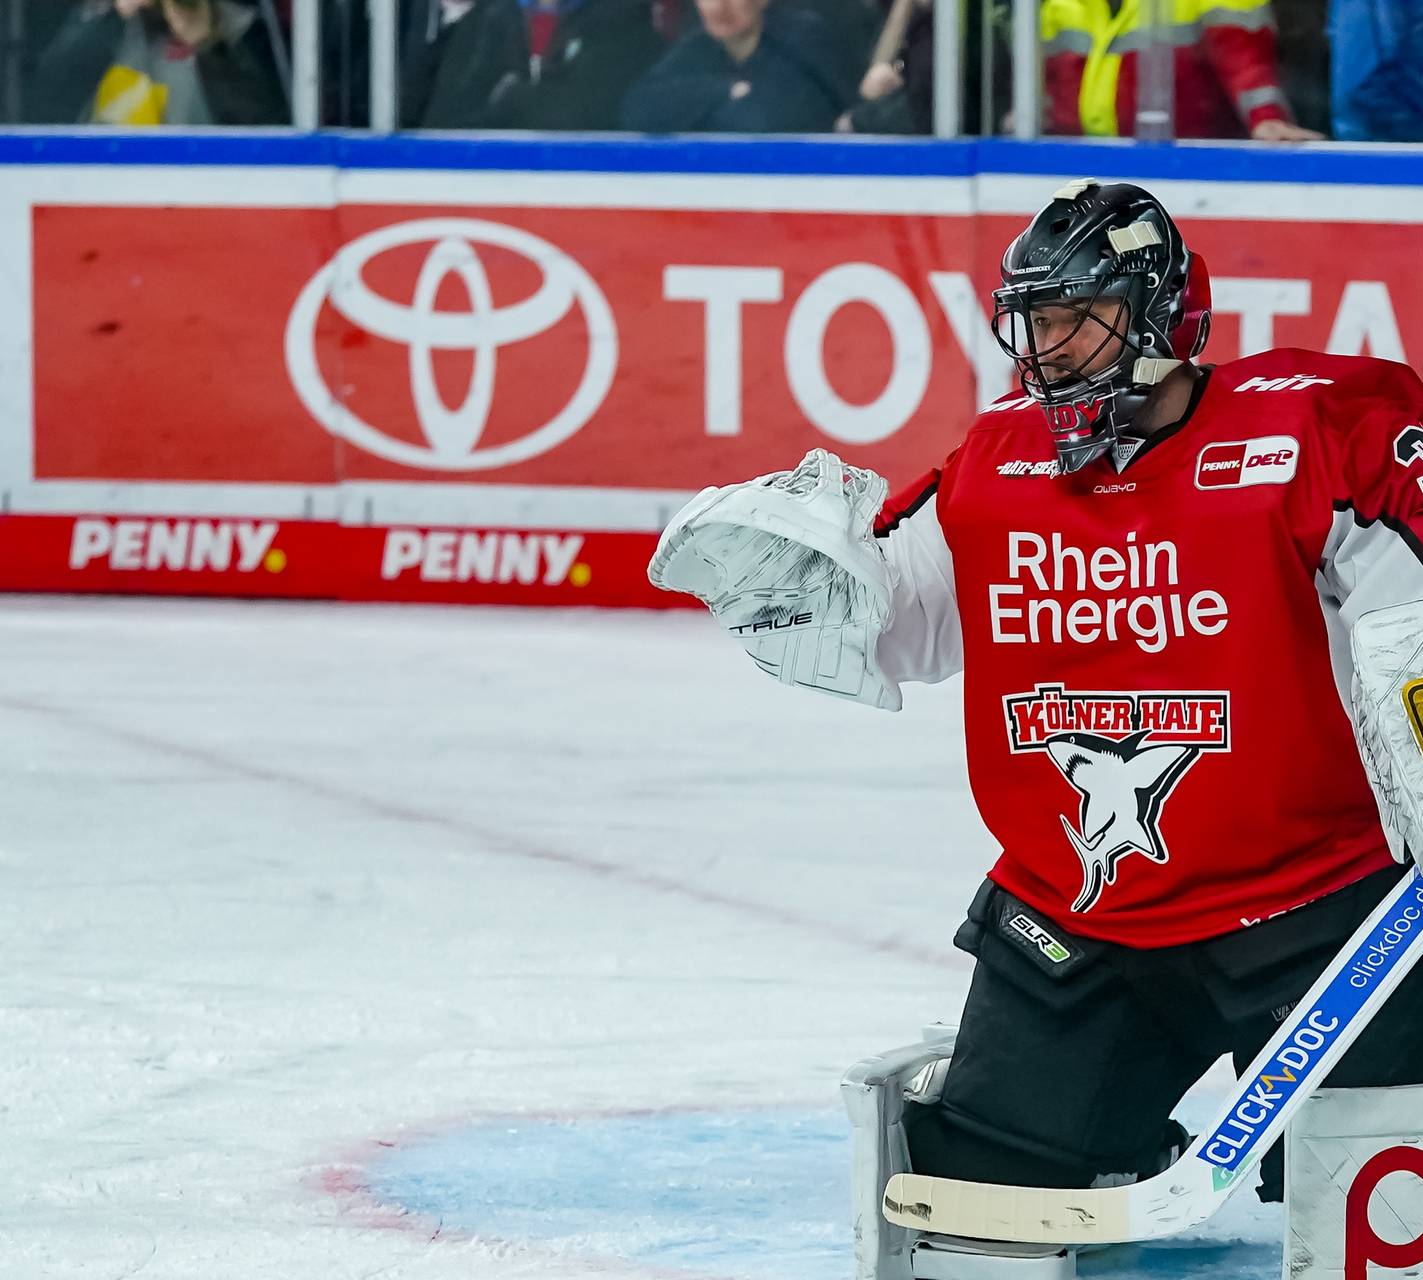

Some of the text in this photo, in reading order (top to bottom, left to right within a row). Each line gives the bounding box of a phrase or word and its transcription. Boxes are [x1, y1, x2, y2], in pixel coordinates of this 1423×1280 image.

[663, 262, 1403, 445] TOYTA
[1233, 374, 1335, 392] HIT
[1008, 530, 1179, 591] Rhein
[728, 612, 813, 634] TRUE
[988, 583, 1229, 654] Energie
[1011, 691, 1224, 744] KÖLNER HAIE
